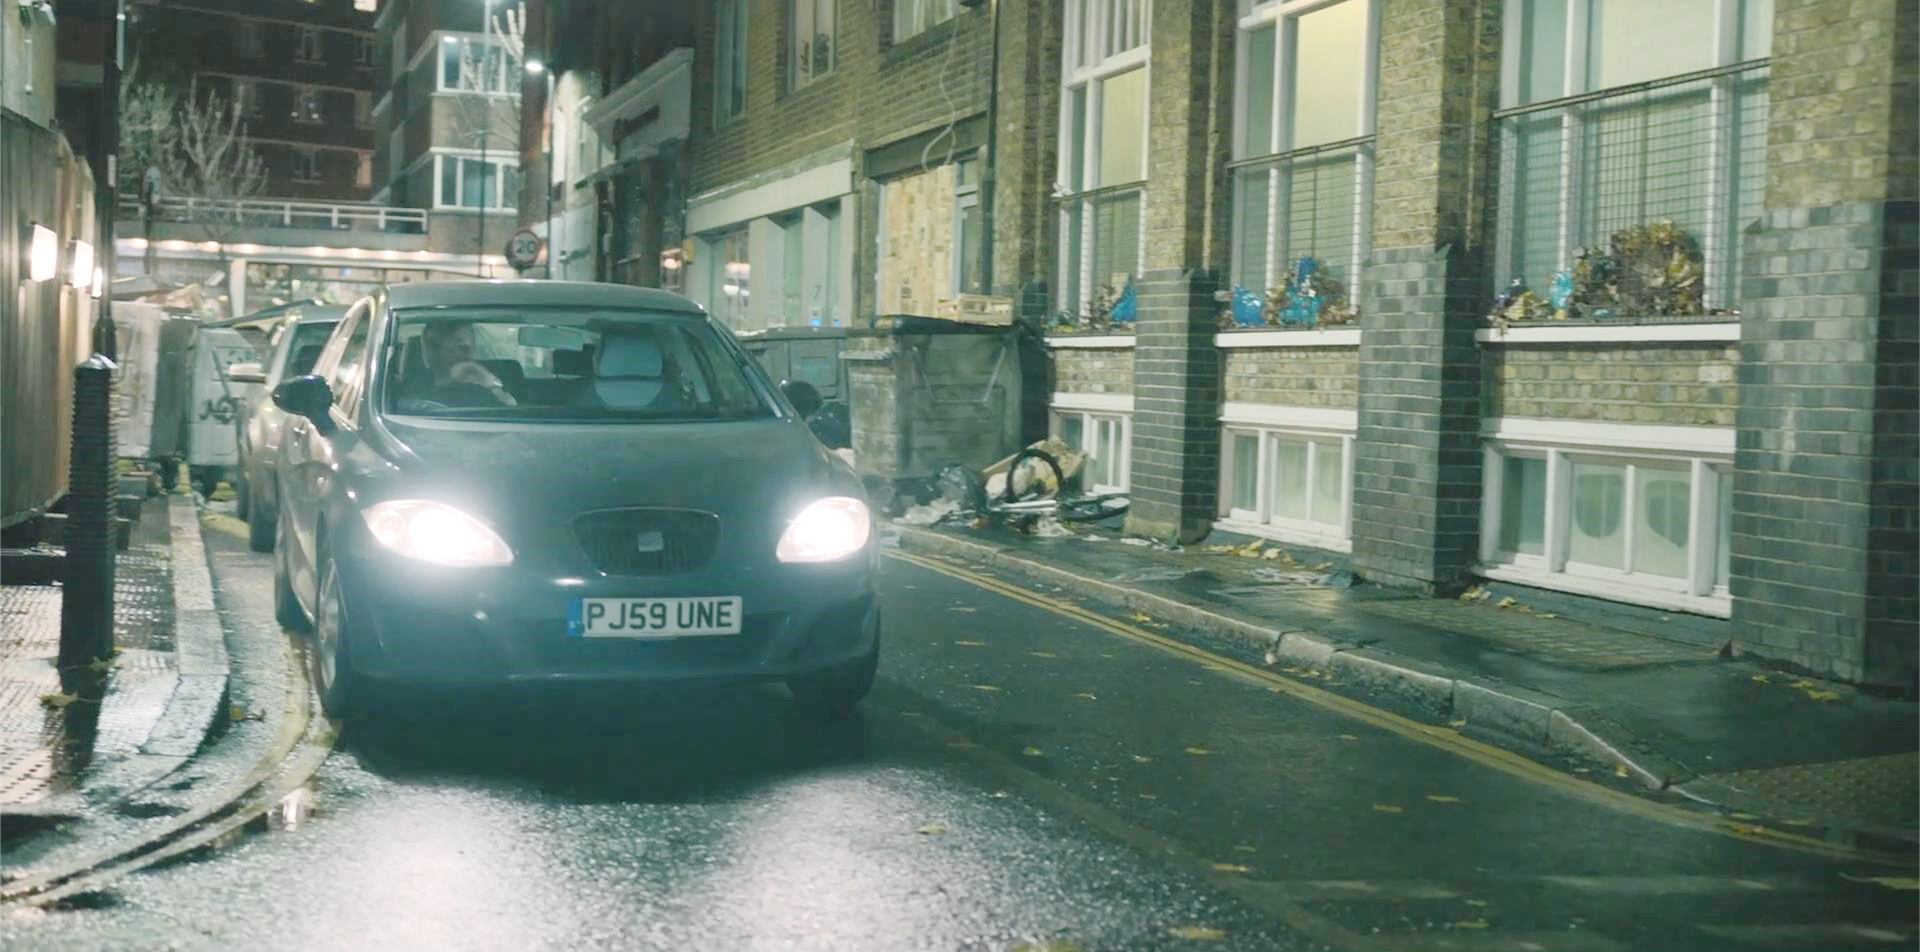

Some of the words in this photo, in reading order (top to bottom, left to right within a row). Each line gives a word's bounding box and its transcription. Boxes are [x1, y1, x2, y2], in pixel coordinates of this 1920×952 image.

[516, 240, 536, 254] 20
[587, 602, 667, 630] PJ59
[677, 601, 734, 629] UNE
